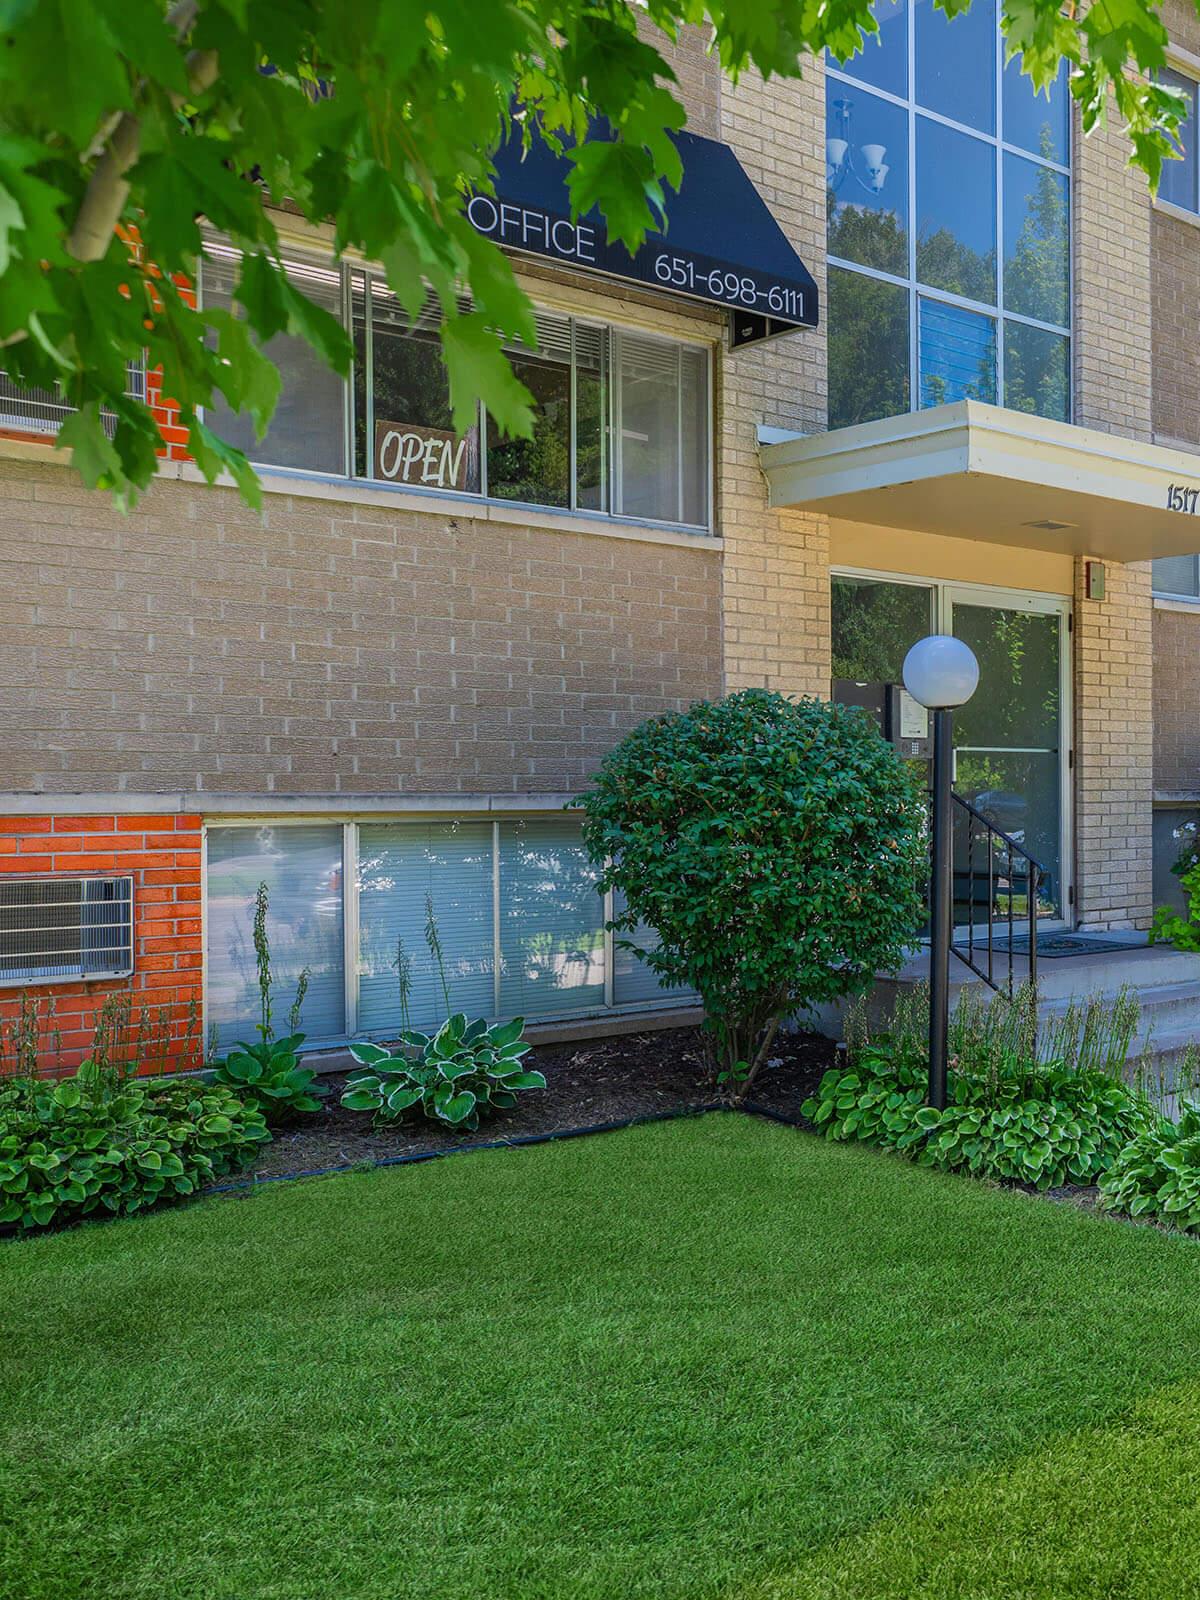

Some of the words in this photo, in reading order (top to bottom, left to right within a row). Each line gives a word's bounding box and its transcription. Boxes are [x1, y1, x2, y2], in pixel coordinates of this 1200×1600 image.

[468, 197, 596, 262] OFFICE
[655, 254, 804, 318] 651-698-6111
[380, 430, 466, 487] OPEN
[1167, 483, 1200, 514] 1517
